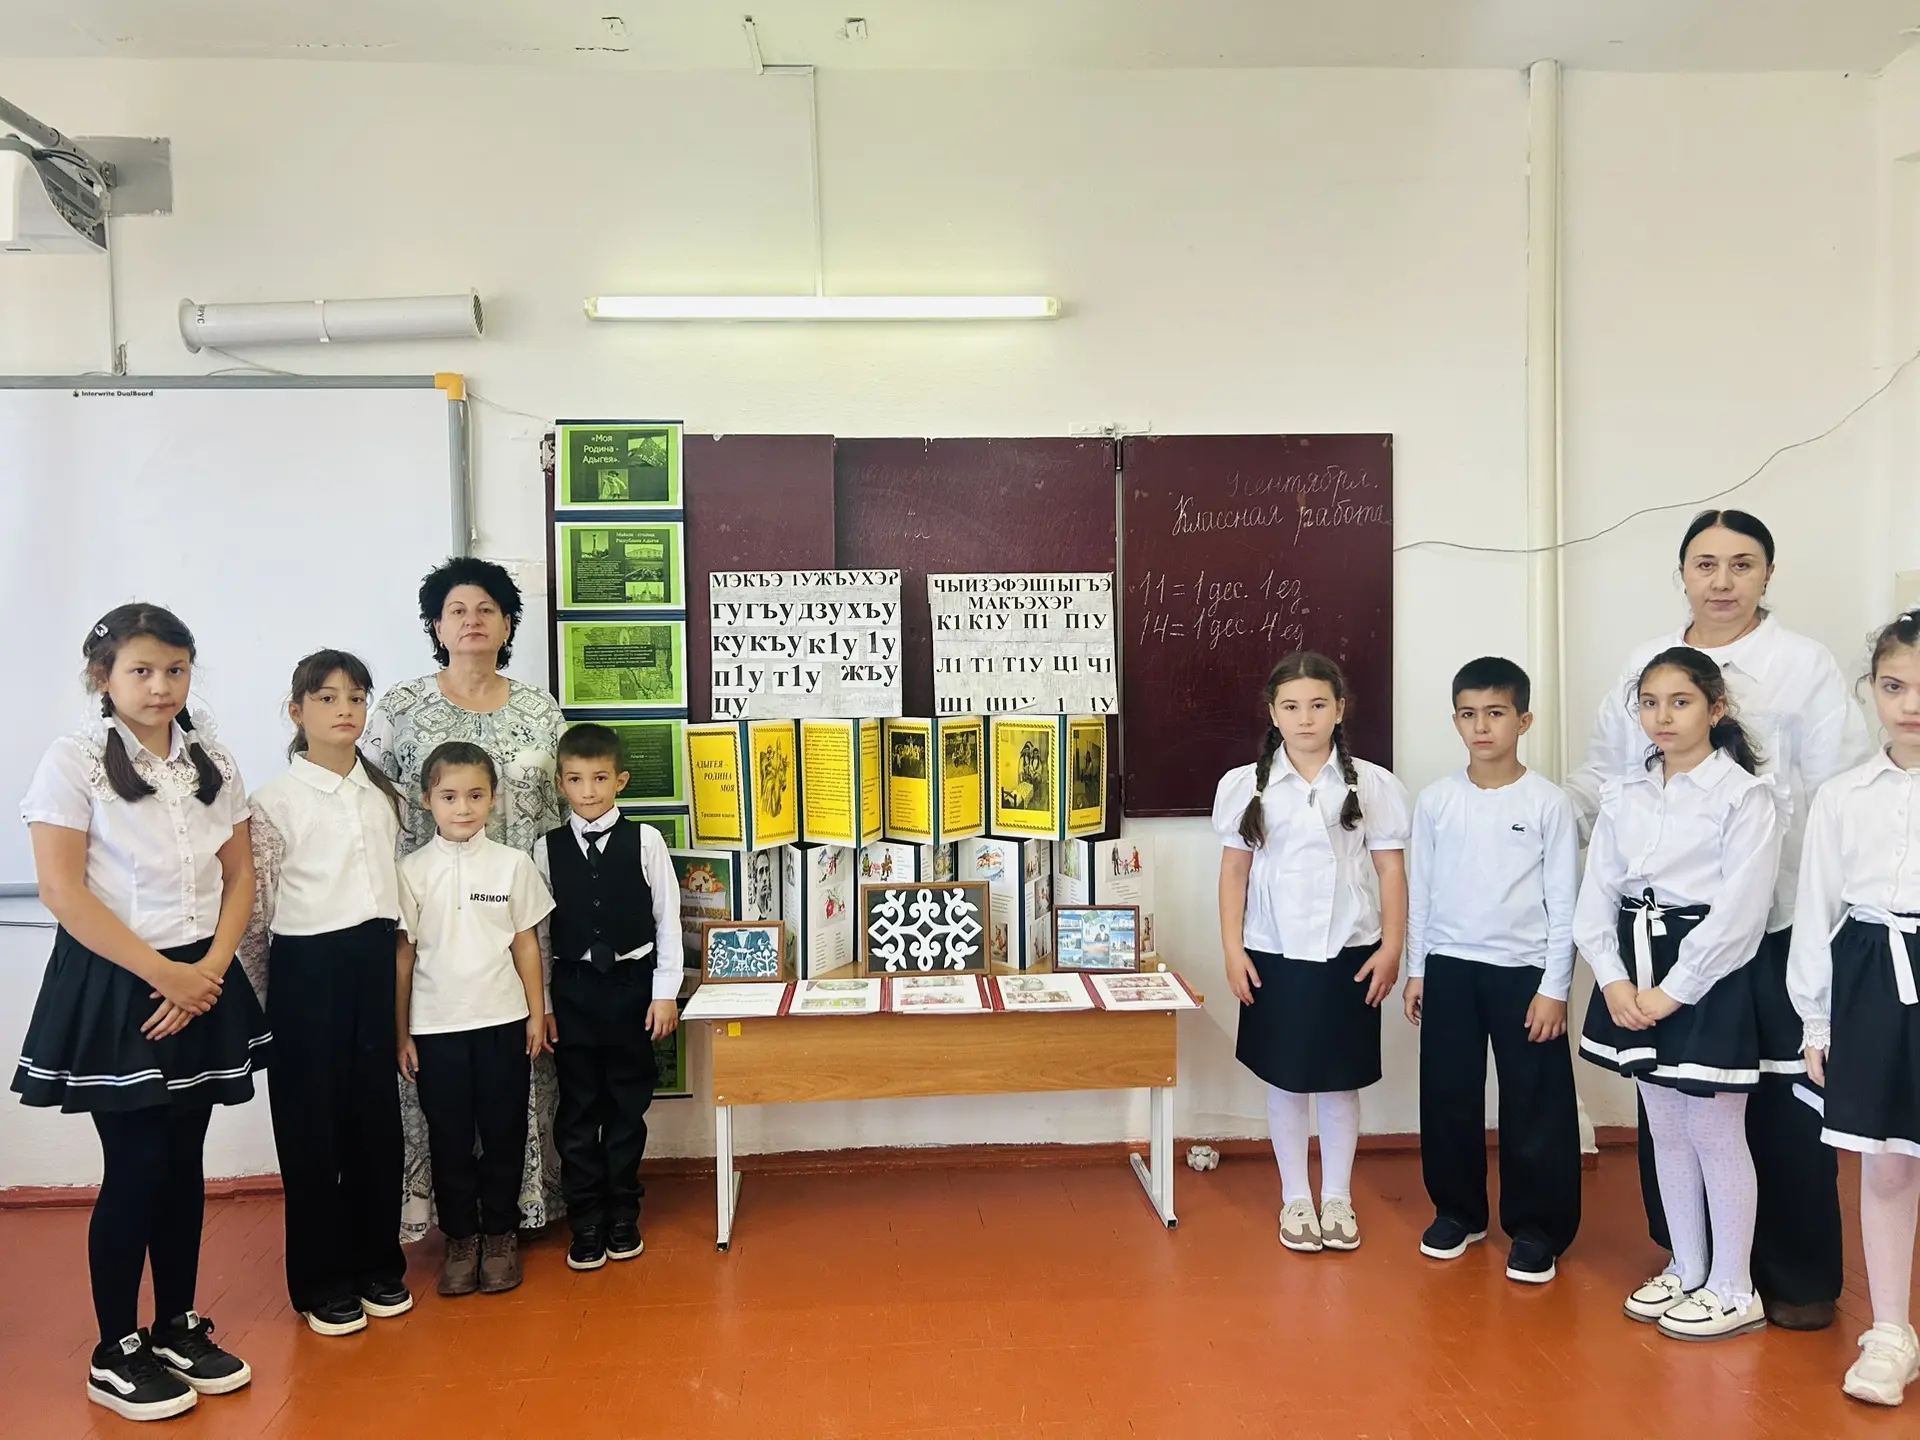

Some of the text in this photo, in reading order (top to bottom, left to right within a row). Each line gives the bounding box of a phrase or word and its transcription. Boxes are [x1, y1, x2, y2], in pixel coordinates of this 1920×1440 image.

[591, 434, 613, 442] «Моя
[583, 444, 615, 453] Родина
[1172, 494, 1284, 536] Классная
[712, 573, 783, 588] МЭКЪЭ
[968, 596, 1073, 609] МАКЪЭХЭР
[798, 603, 843, 626] дзу
[695, 760, 723, 769] АДЫГЕЯ
[703, 772, 732, 781] РОДИНА
[720, 784, 735, 793] МОЯ
